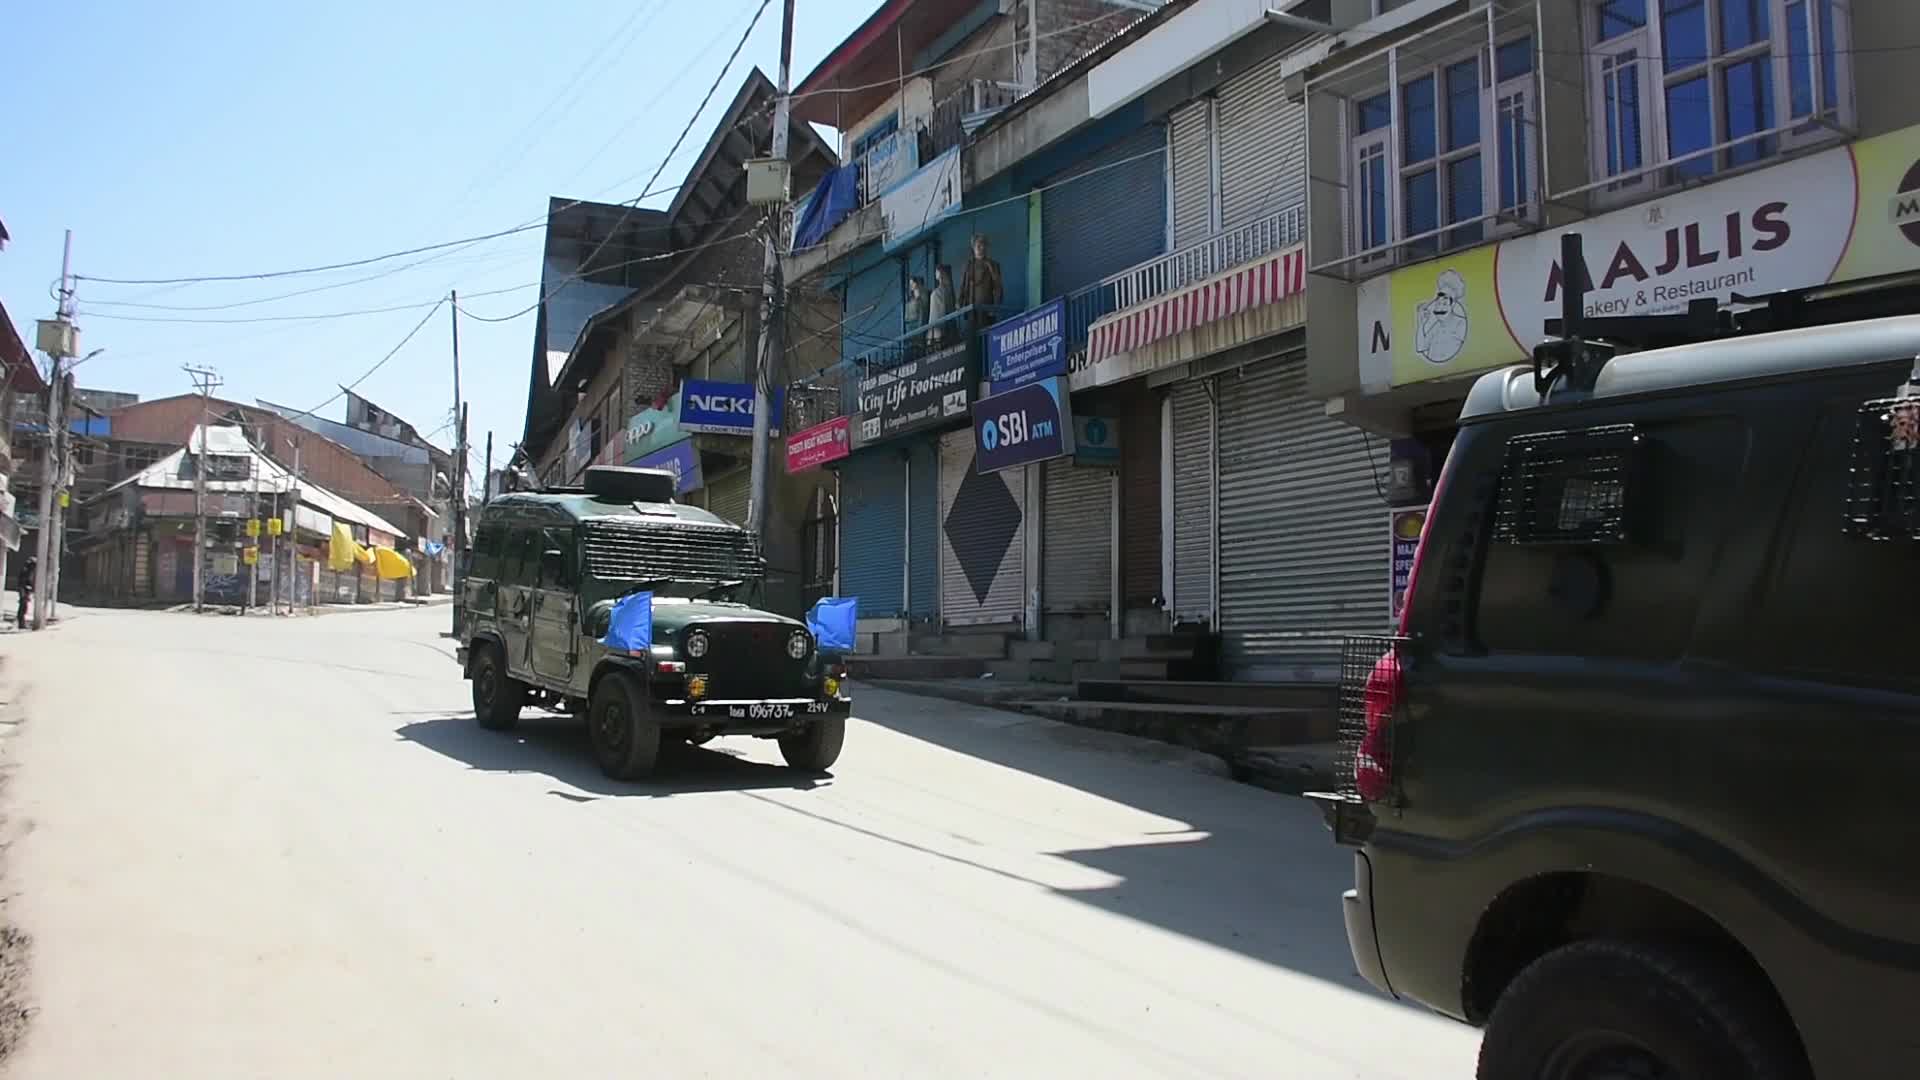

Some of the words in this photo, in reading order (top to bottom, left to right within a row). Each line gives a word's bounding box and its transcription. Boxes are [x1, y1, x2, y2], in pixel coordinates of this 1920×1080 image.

[1544, 201, 1791, 302] MAJLIS
[1583, 295, 1630, 319] akery
[1635, 290, 1648, 307] &
[1653, 266, 1755, 302] Restaurant
[1006, 343, 1047, 366] Enterprises
[689, 393, 755, 415] NOKI
[864, 394, 884, 416] City
[886, 380, 907, 411] Life
[910, 366, 965, 397] Footwear
[624, 420, 653, 445] oppo
[998, 409, 1029, 447] SBI
[1031, 420, 1053, 440] ATM
[1396, 543, 1417, 556] MAJ
